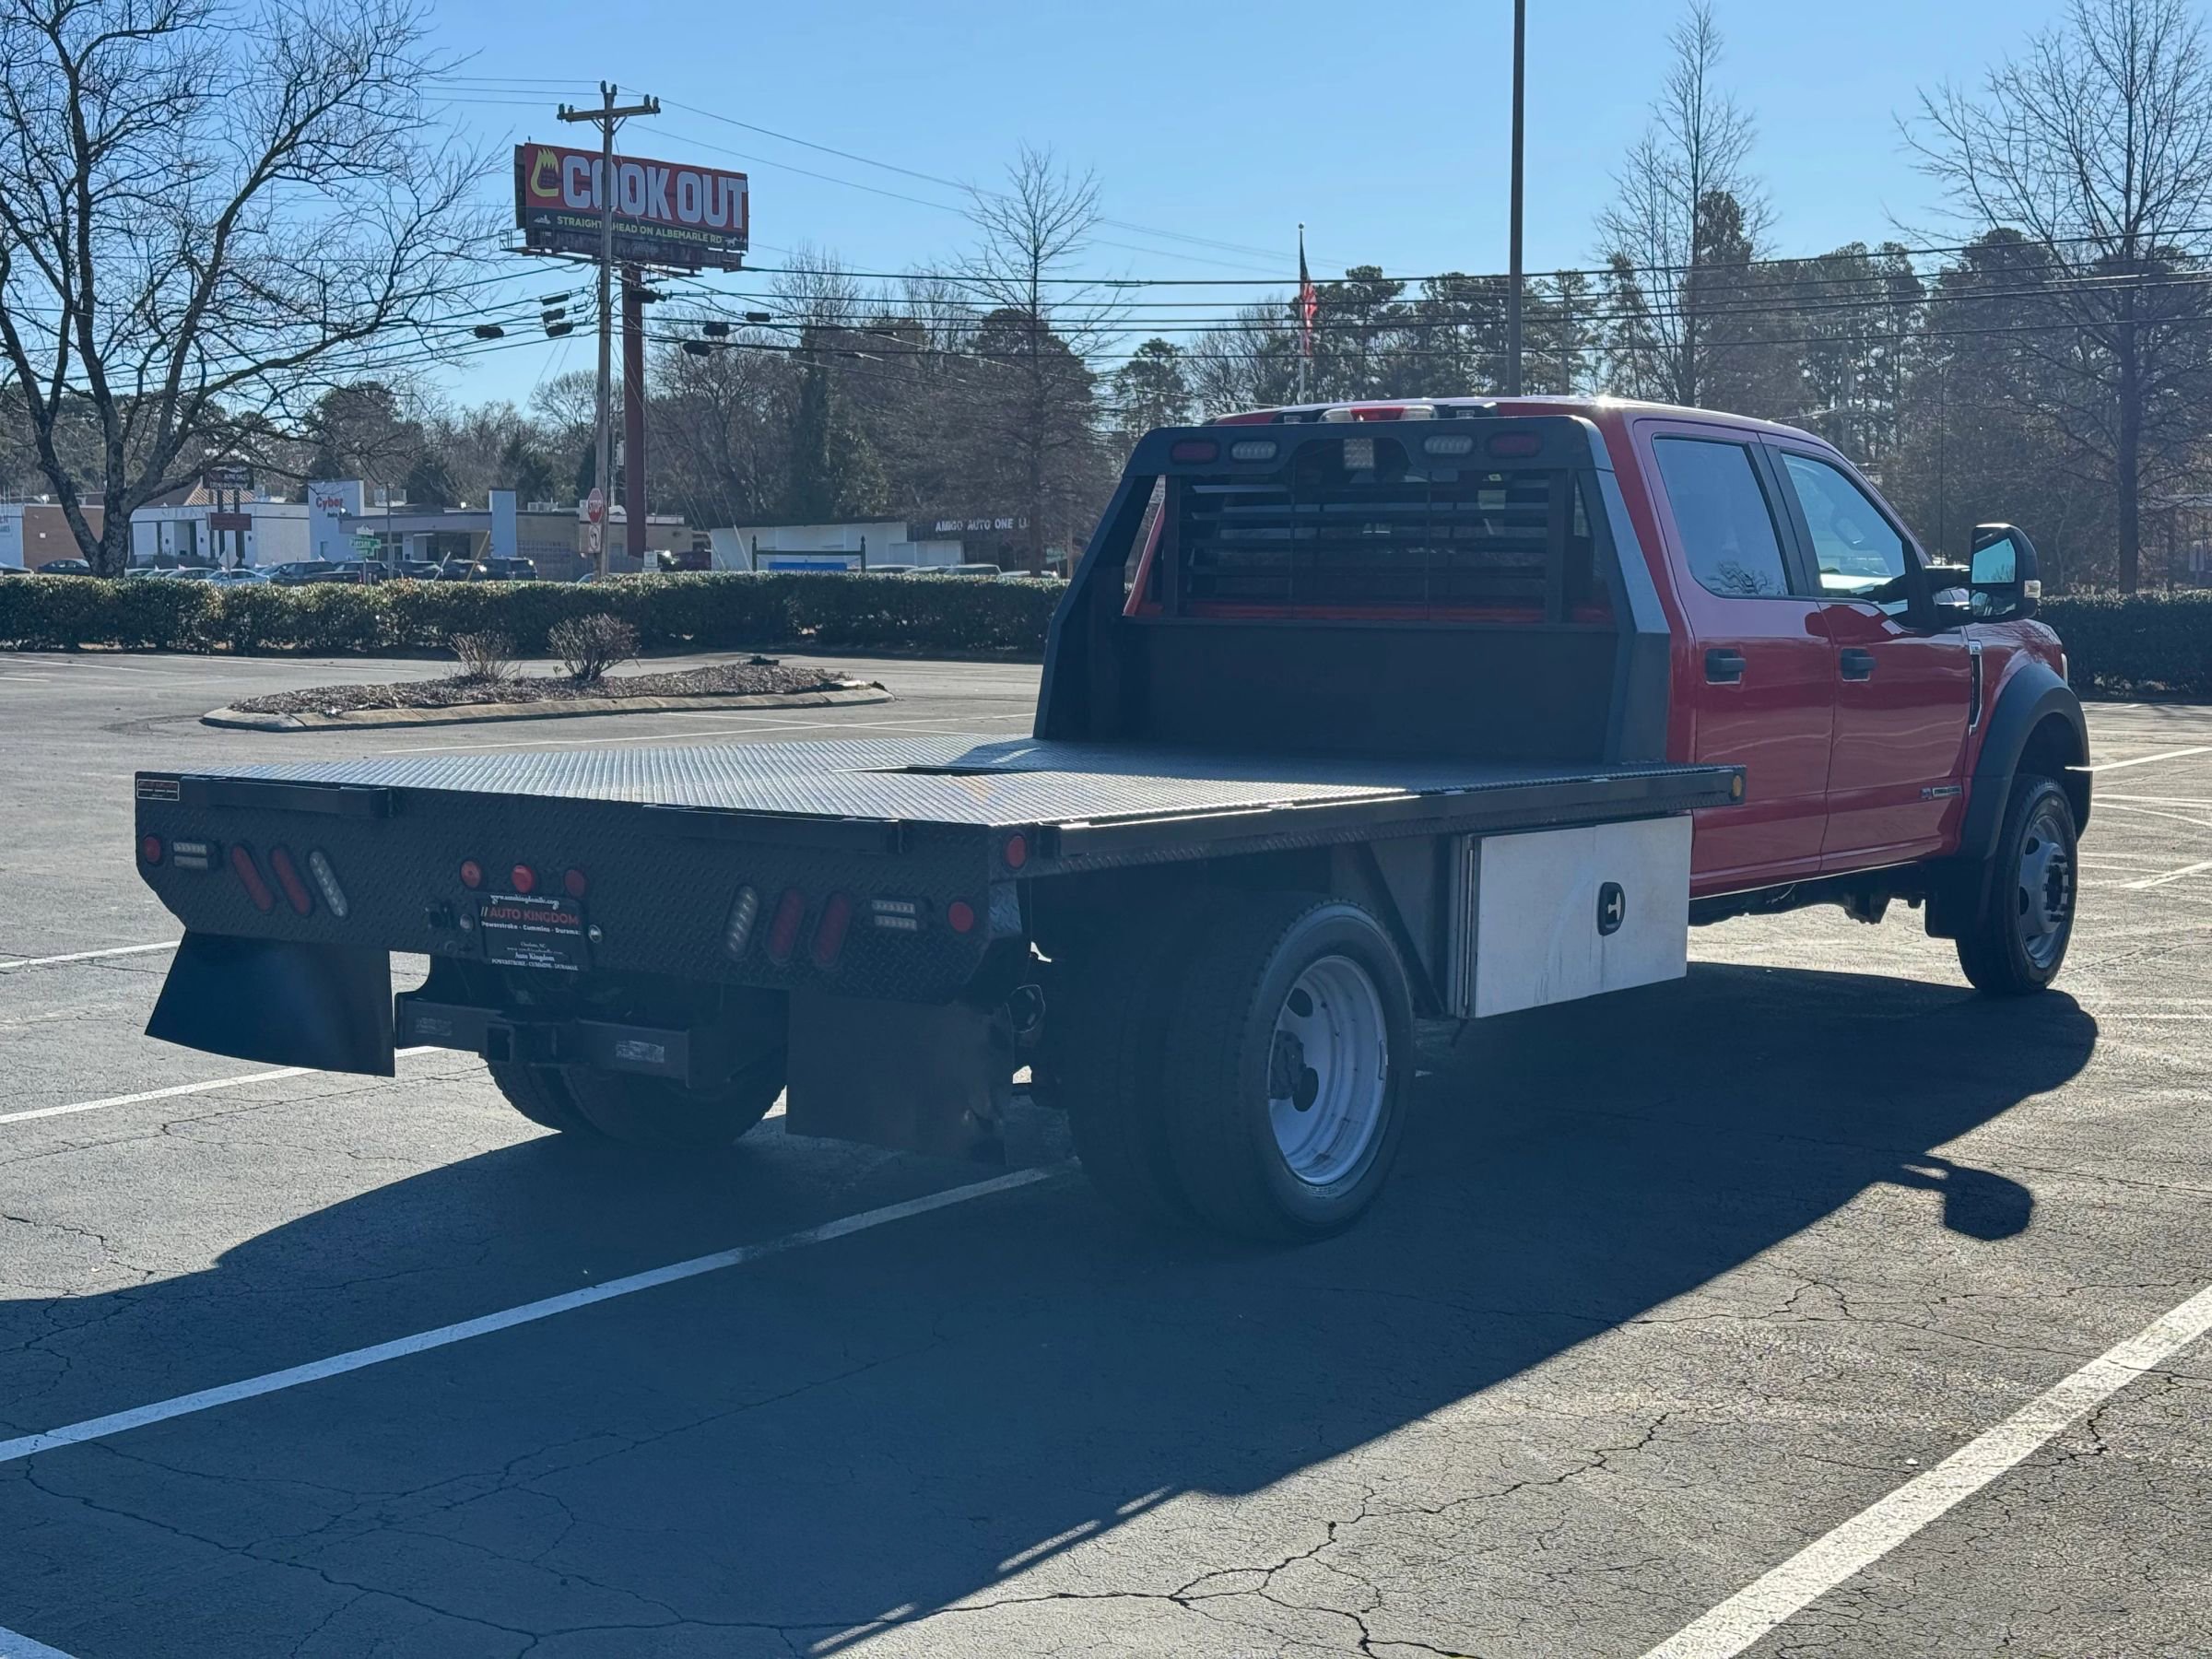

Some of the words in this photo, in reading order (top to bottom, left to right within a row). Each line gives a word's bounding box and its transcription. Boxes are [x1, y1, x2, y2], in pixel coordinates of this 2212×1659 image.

[562, 155, 672, 220] COOK
[677, 171, 747, 229] OUT
[557, 216, 603, 229] STRAIGHT
[610, 223, 638, 233] HEAD
[640, 226, 653, 235] ON
[655, 228, 708, 242] ALBEMARLE
[711, 235, 723, 244] RD
[315, 496, 343, 512] Cyber
[589, 500, 602, 513] STOP
[935, 521, 963, 532] AMIGO
[967, 519, 991, 531] AUTO
[994, 518, 1014, 529] ONE
[490, 907, 521, 920] AUTO
[524, 910, 579, 925] KINGDOM
[480, 921, 518, 930] Powerstroke
[523, 924, 550, 933] Cummins
